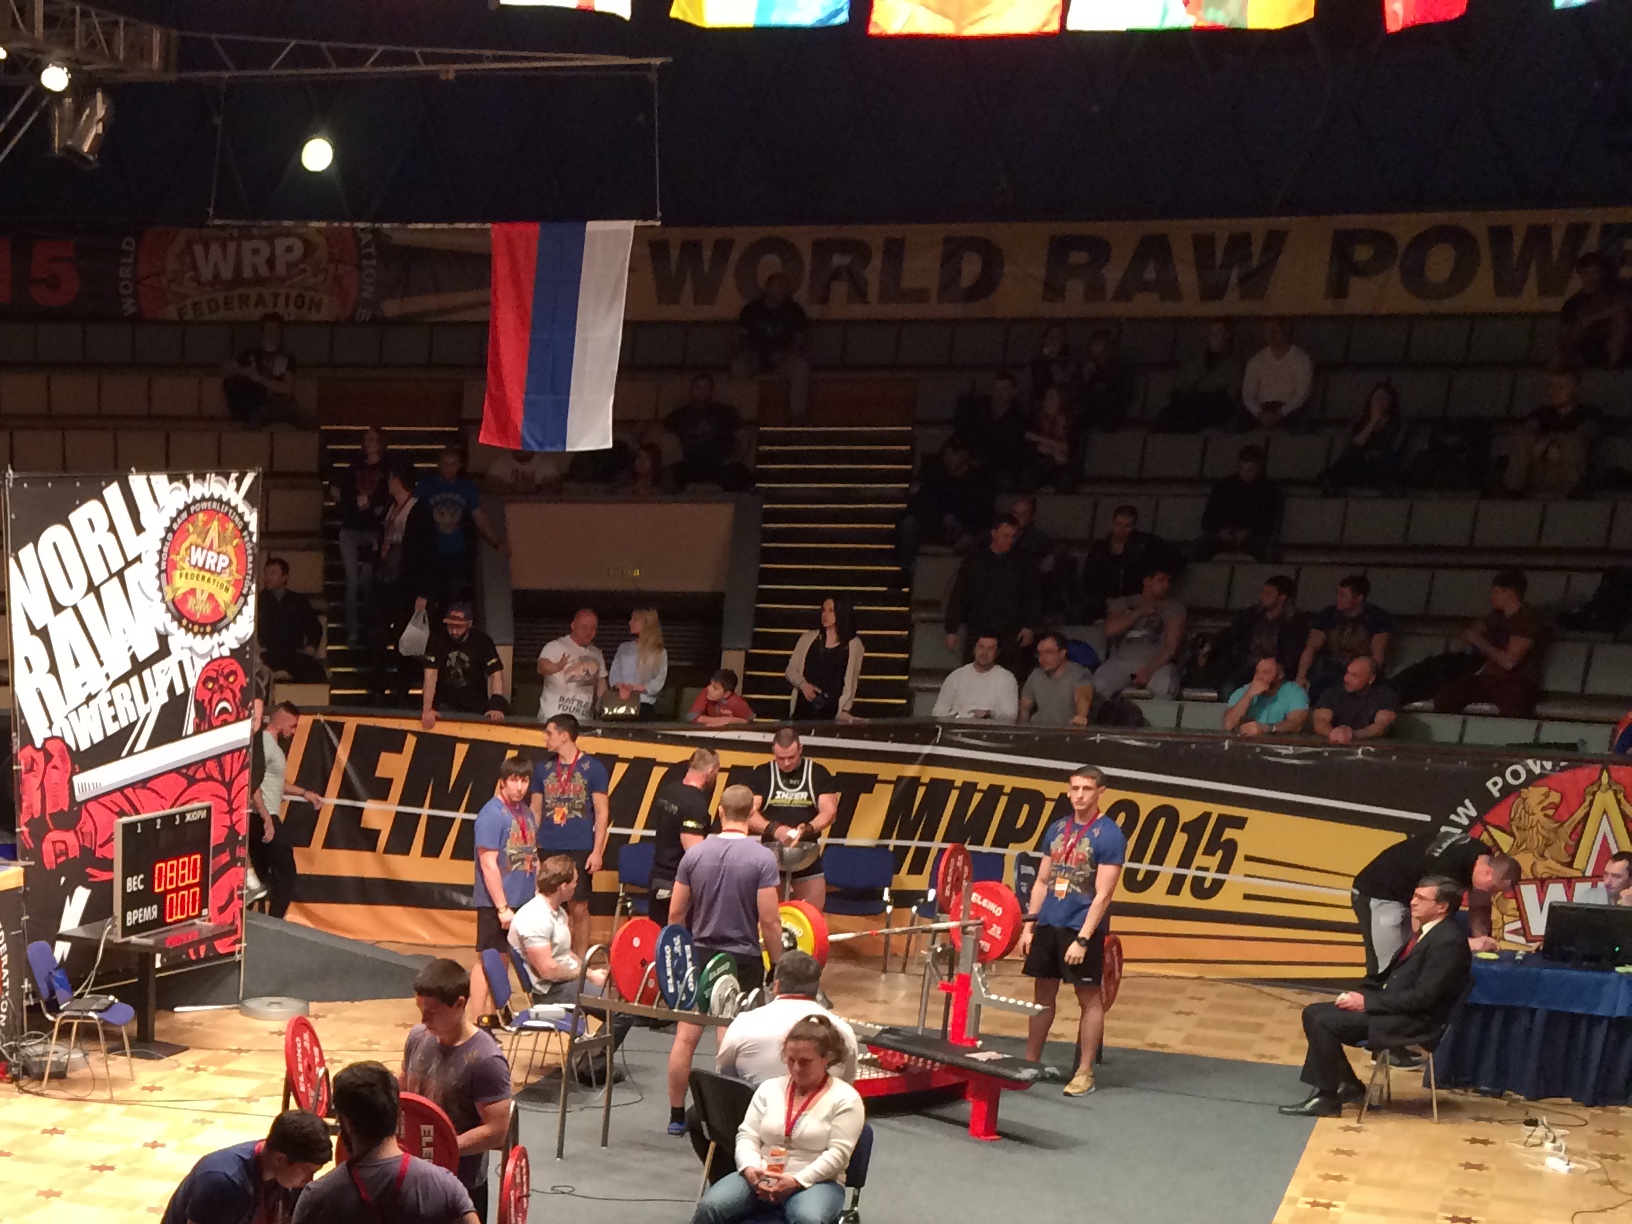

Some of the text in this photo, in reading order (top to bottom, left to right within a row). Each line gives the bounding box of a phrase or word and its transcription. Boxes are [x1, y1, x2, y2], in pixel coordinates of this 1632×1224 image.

[192, 236, 305, 281] WRP
[648, 235, 1004, 306] WORLD
[1040, 229, 1290, 302] RAW
[118, 236, 137, 317] WORLD
[175, 291, 325, 321] FEDERATION
[172, 509, 188, 530] RAW
[189, 545, 230, 574] WRP
[178, 572, 231, 594] FEDERATION
[774, 790, 809, 801] INZER
[136, 808, 208, 834] 1 2 3 ЖЮРИ
[879, 774, 1074, 876] МИР
[125, 873, 145, 894] ВЕС
[125, 904, 159, 928] ВРЕМЯ
[970, 891, 1003, 917] ELEIKO
[780, 919, 804, 938] LEIKO
[664, 944, 676, 994] ELEIKO
[419, 1123, 434, 1166] ELE
